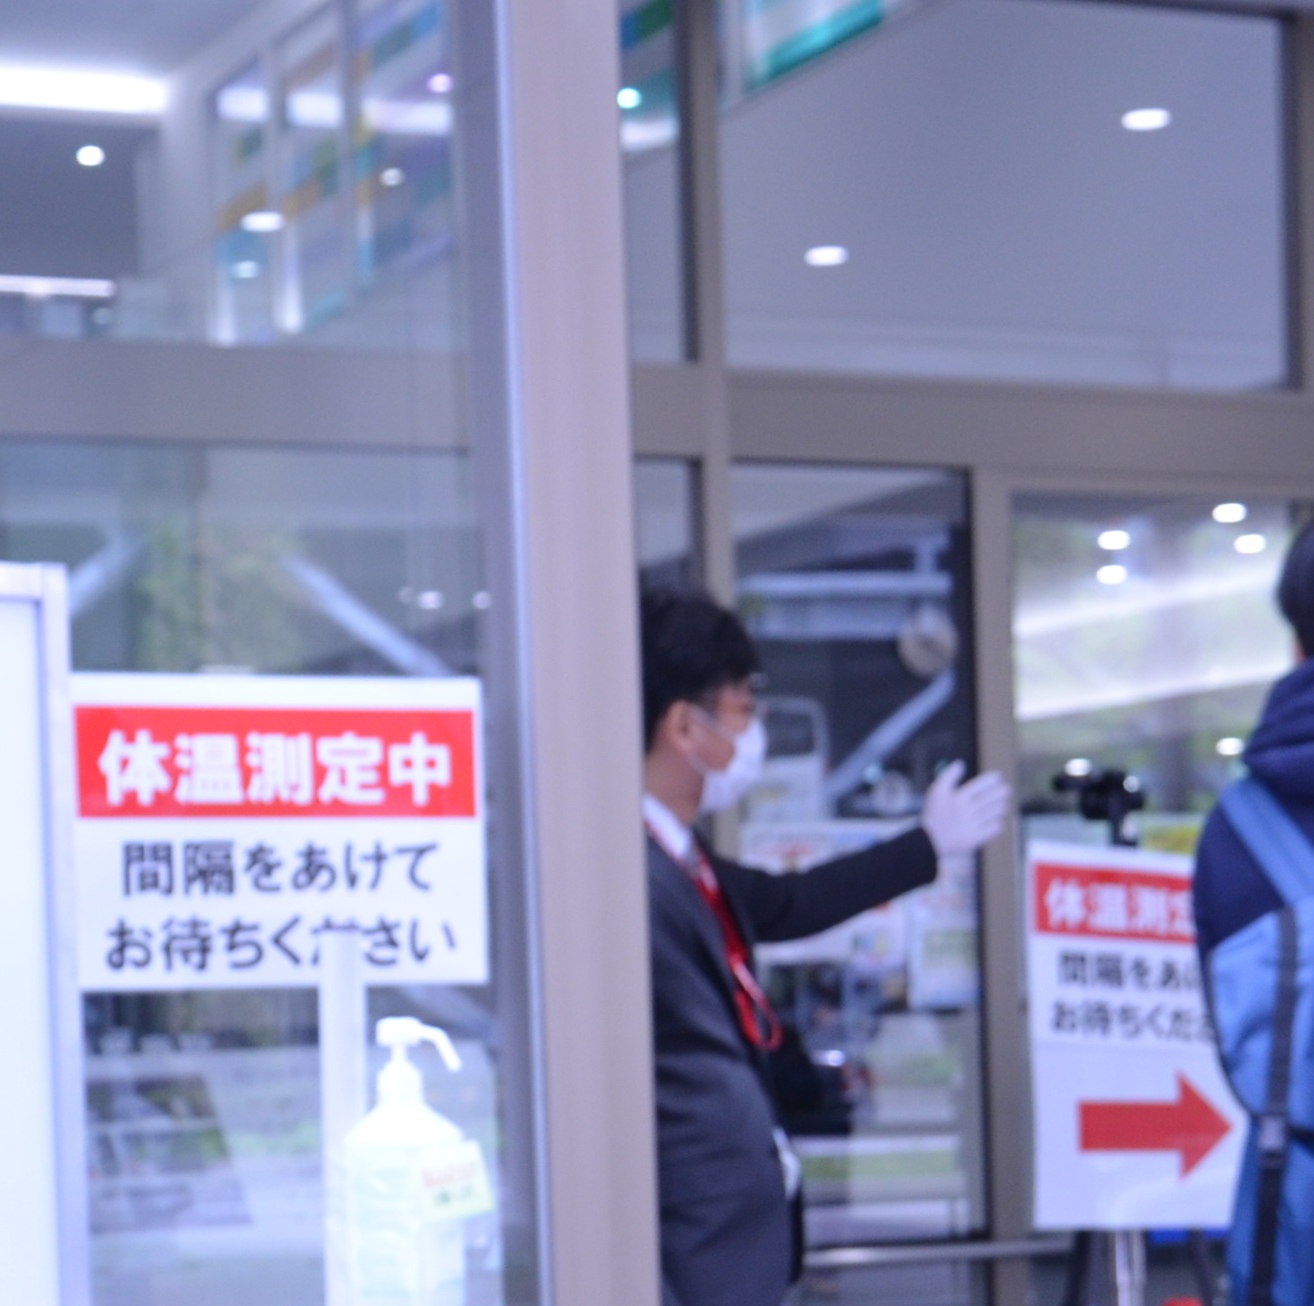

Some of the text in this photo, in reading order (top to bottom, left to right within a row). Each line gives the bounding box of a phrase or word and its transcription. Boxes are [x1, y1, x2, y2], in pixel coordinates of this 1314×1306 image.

[97, 728, 453, 807] 体温測定中
[121, 839, 439, 897] 間隔をあけて
